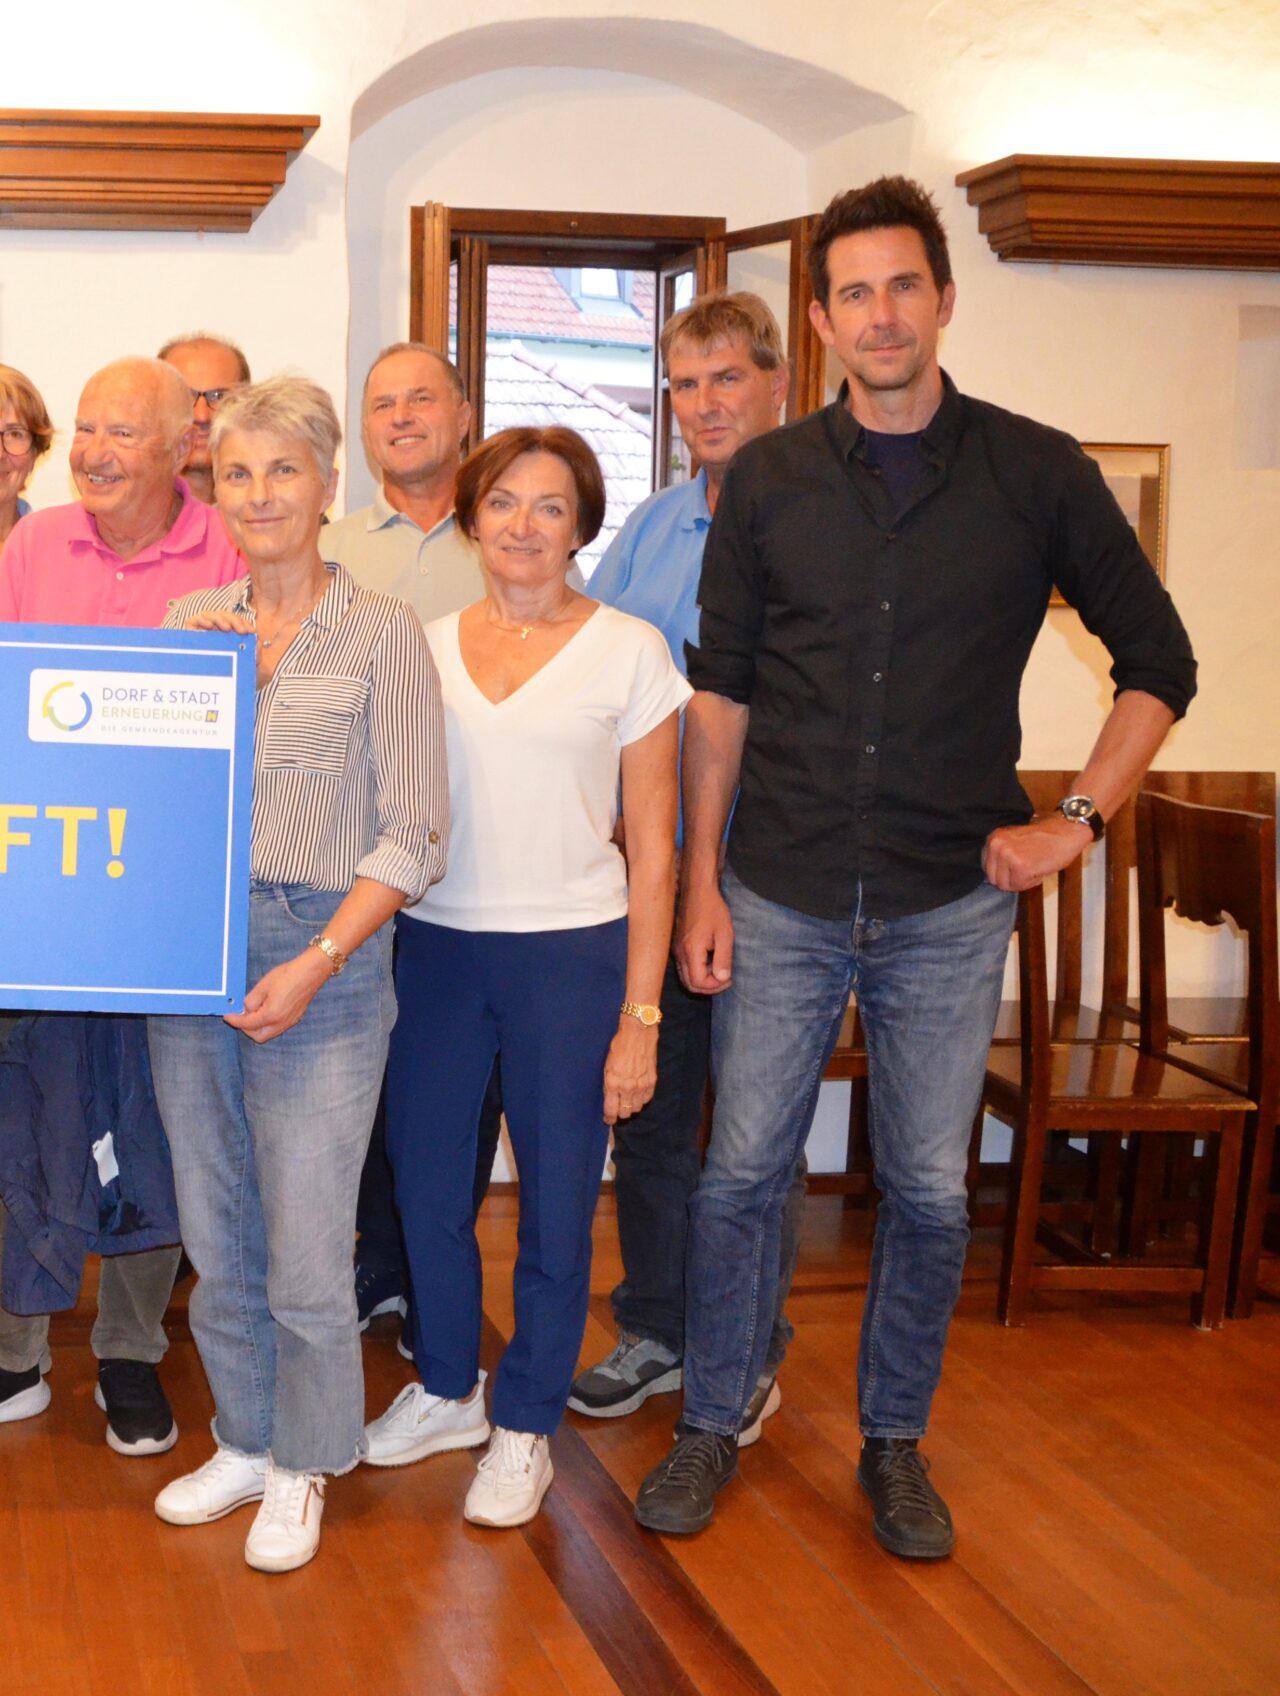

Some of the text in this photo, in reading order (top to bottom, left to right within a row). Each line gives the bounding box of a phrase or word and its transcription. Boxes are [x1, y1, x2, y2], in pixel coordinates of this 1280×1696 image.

[102, 687, 219, 705] DORF & STADT
[101, 706, 203, 721] ERNEUERUNG
[122, 726, 218, 736] GEMEINDEAGENTUR
